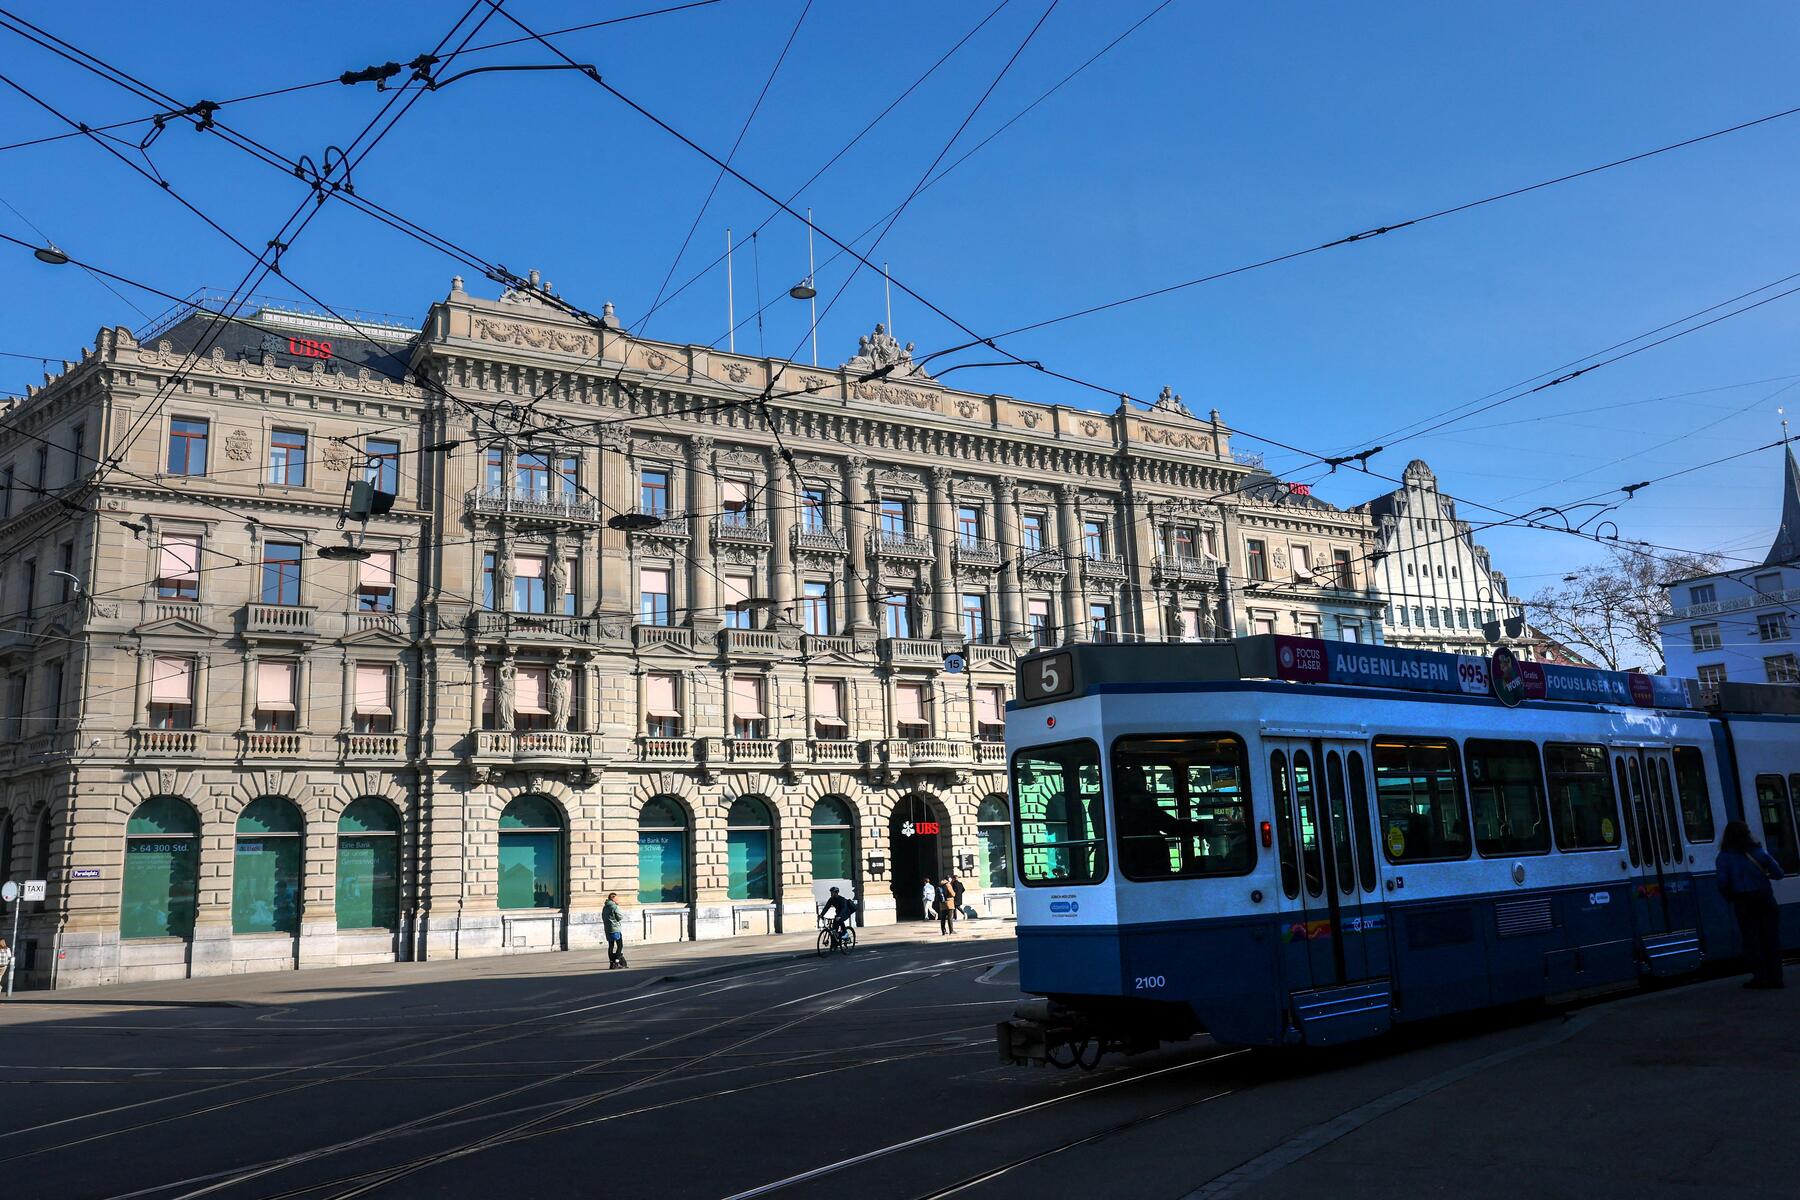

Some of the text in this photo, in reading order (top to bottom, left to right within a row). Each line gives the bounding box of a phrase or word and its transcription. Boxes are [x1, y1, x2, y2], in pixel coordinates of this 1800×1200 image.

[289, 337, 334, 359] UBS
[1296, 647, 1321, 660] FOCUS
[948, 659, 960, 669] 15
[1297, 659, 1321, 671] LASER
[1336, 654, 1449, 681] AUGENLASERN
[1041, 658, 1059, 693] 5
[915, 822, 940, 835] UBS
[140, 844, 151, 853] 64
[153, 844, 170, 852] 300
[172, 843, 189, 852] Std.
[1135, 975, 1166, 989] 2100
